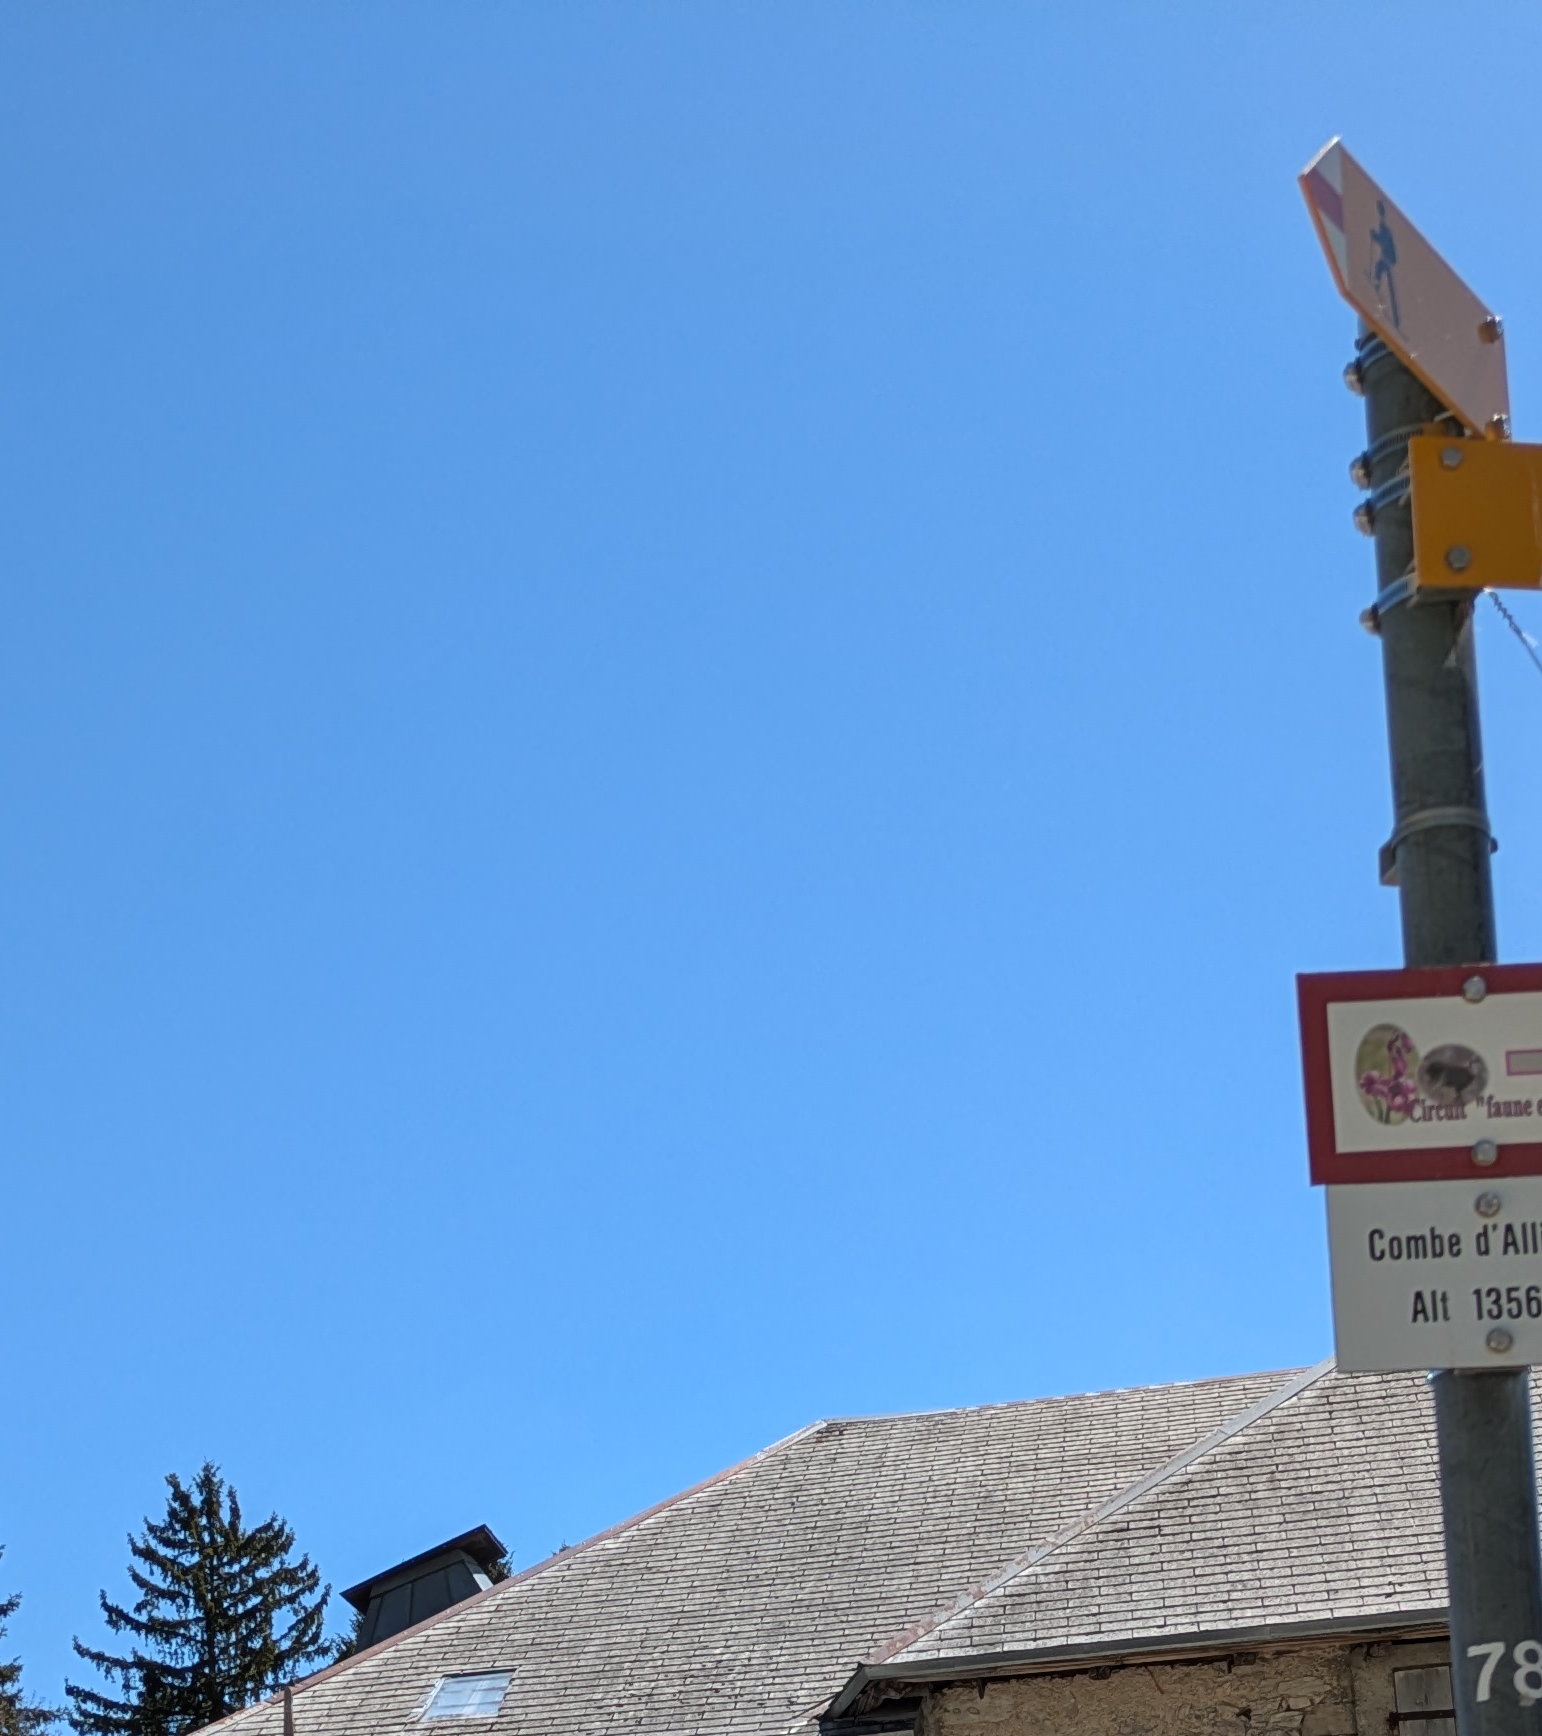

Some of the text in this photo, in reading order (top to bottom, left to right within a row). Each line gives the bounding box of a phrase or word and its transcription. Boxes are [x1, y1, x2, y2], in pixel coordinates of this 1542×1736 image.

[1410, 1098, 1467, 1123] Circuit
[1368, 1226, 1462, 1262] Combe
[1411, 1289, 1451, 1324] Alt
